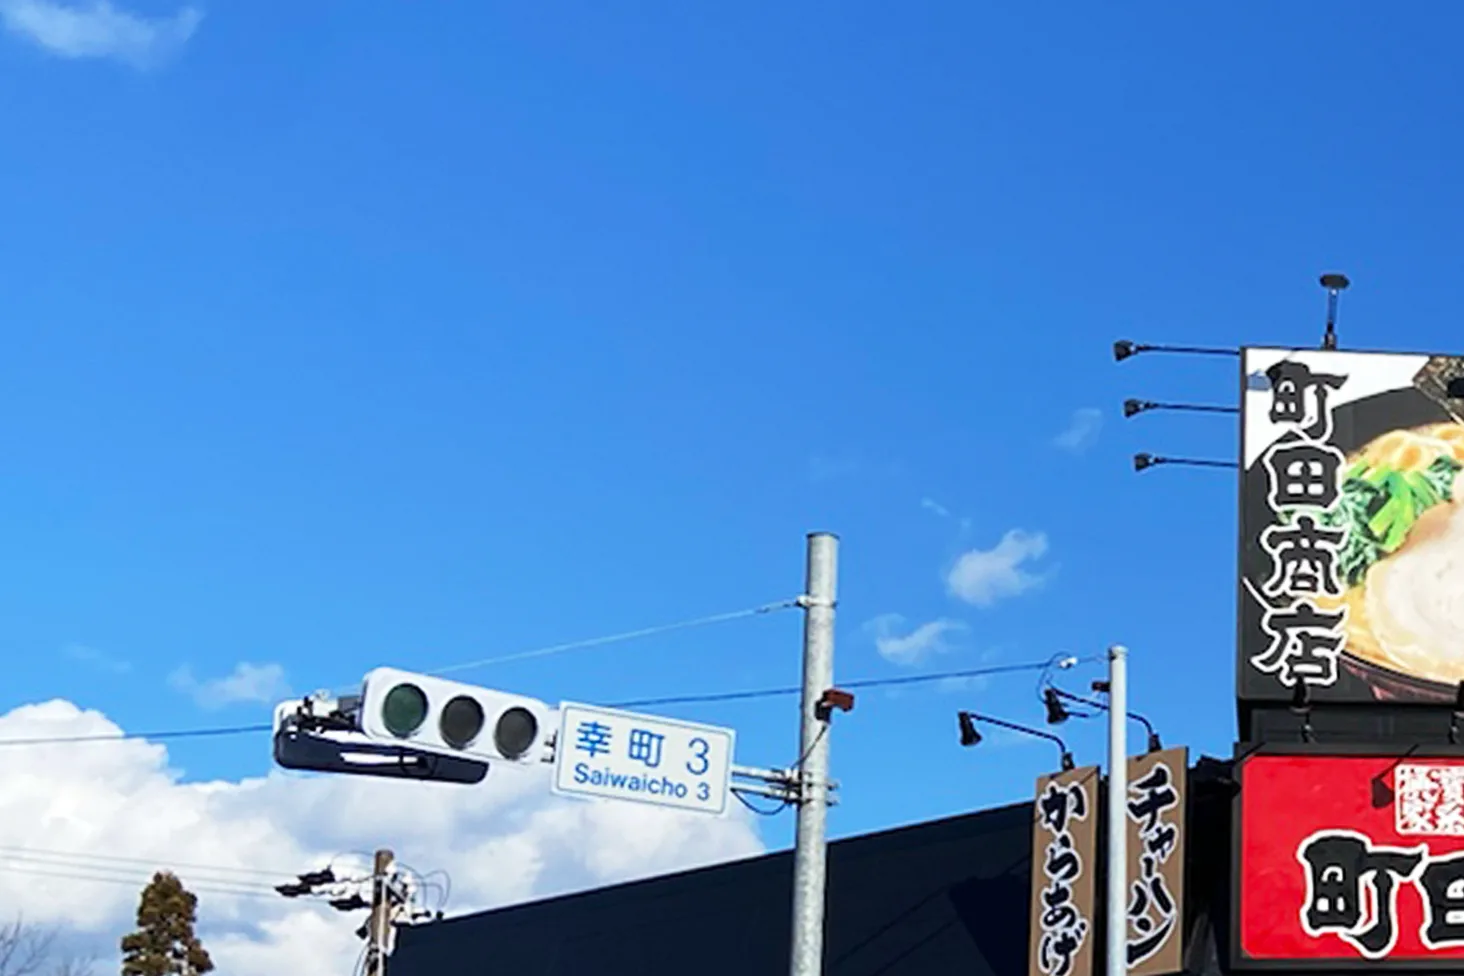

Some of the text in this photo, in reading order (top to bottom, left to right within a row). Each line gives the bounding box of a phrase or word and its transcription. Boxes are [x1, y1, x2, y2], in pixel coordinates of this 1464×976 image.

[1253, 360, 1348, 687] 町田商店
[574, 762, 711, 801] Saiwaicho 3
[1127, 762, 1180, 968] チャーハン
